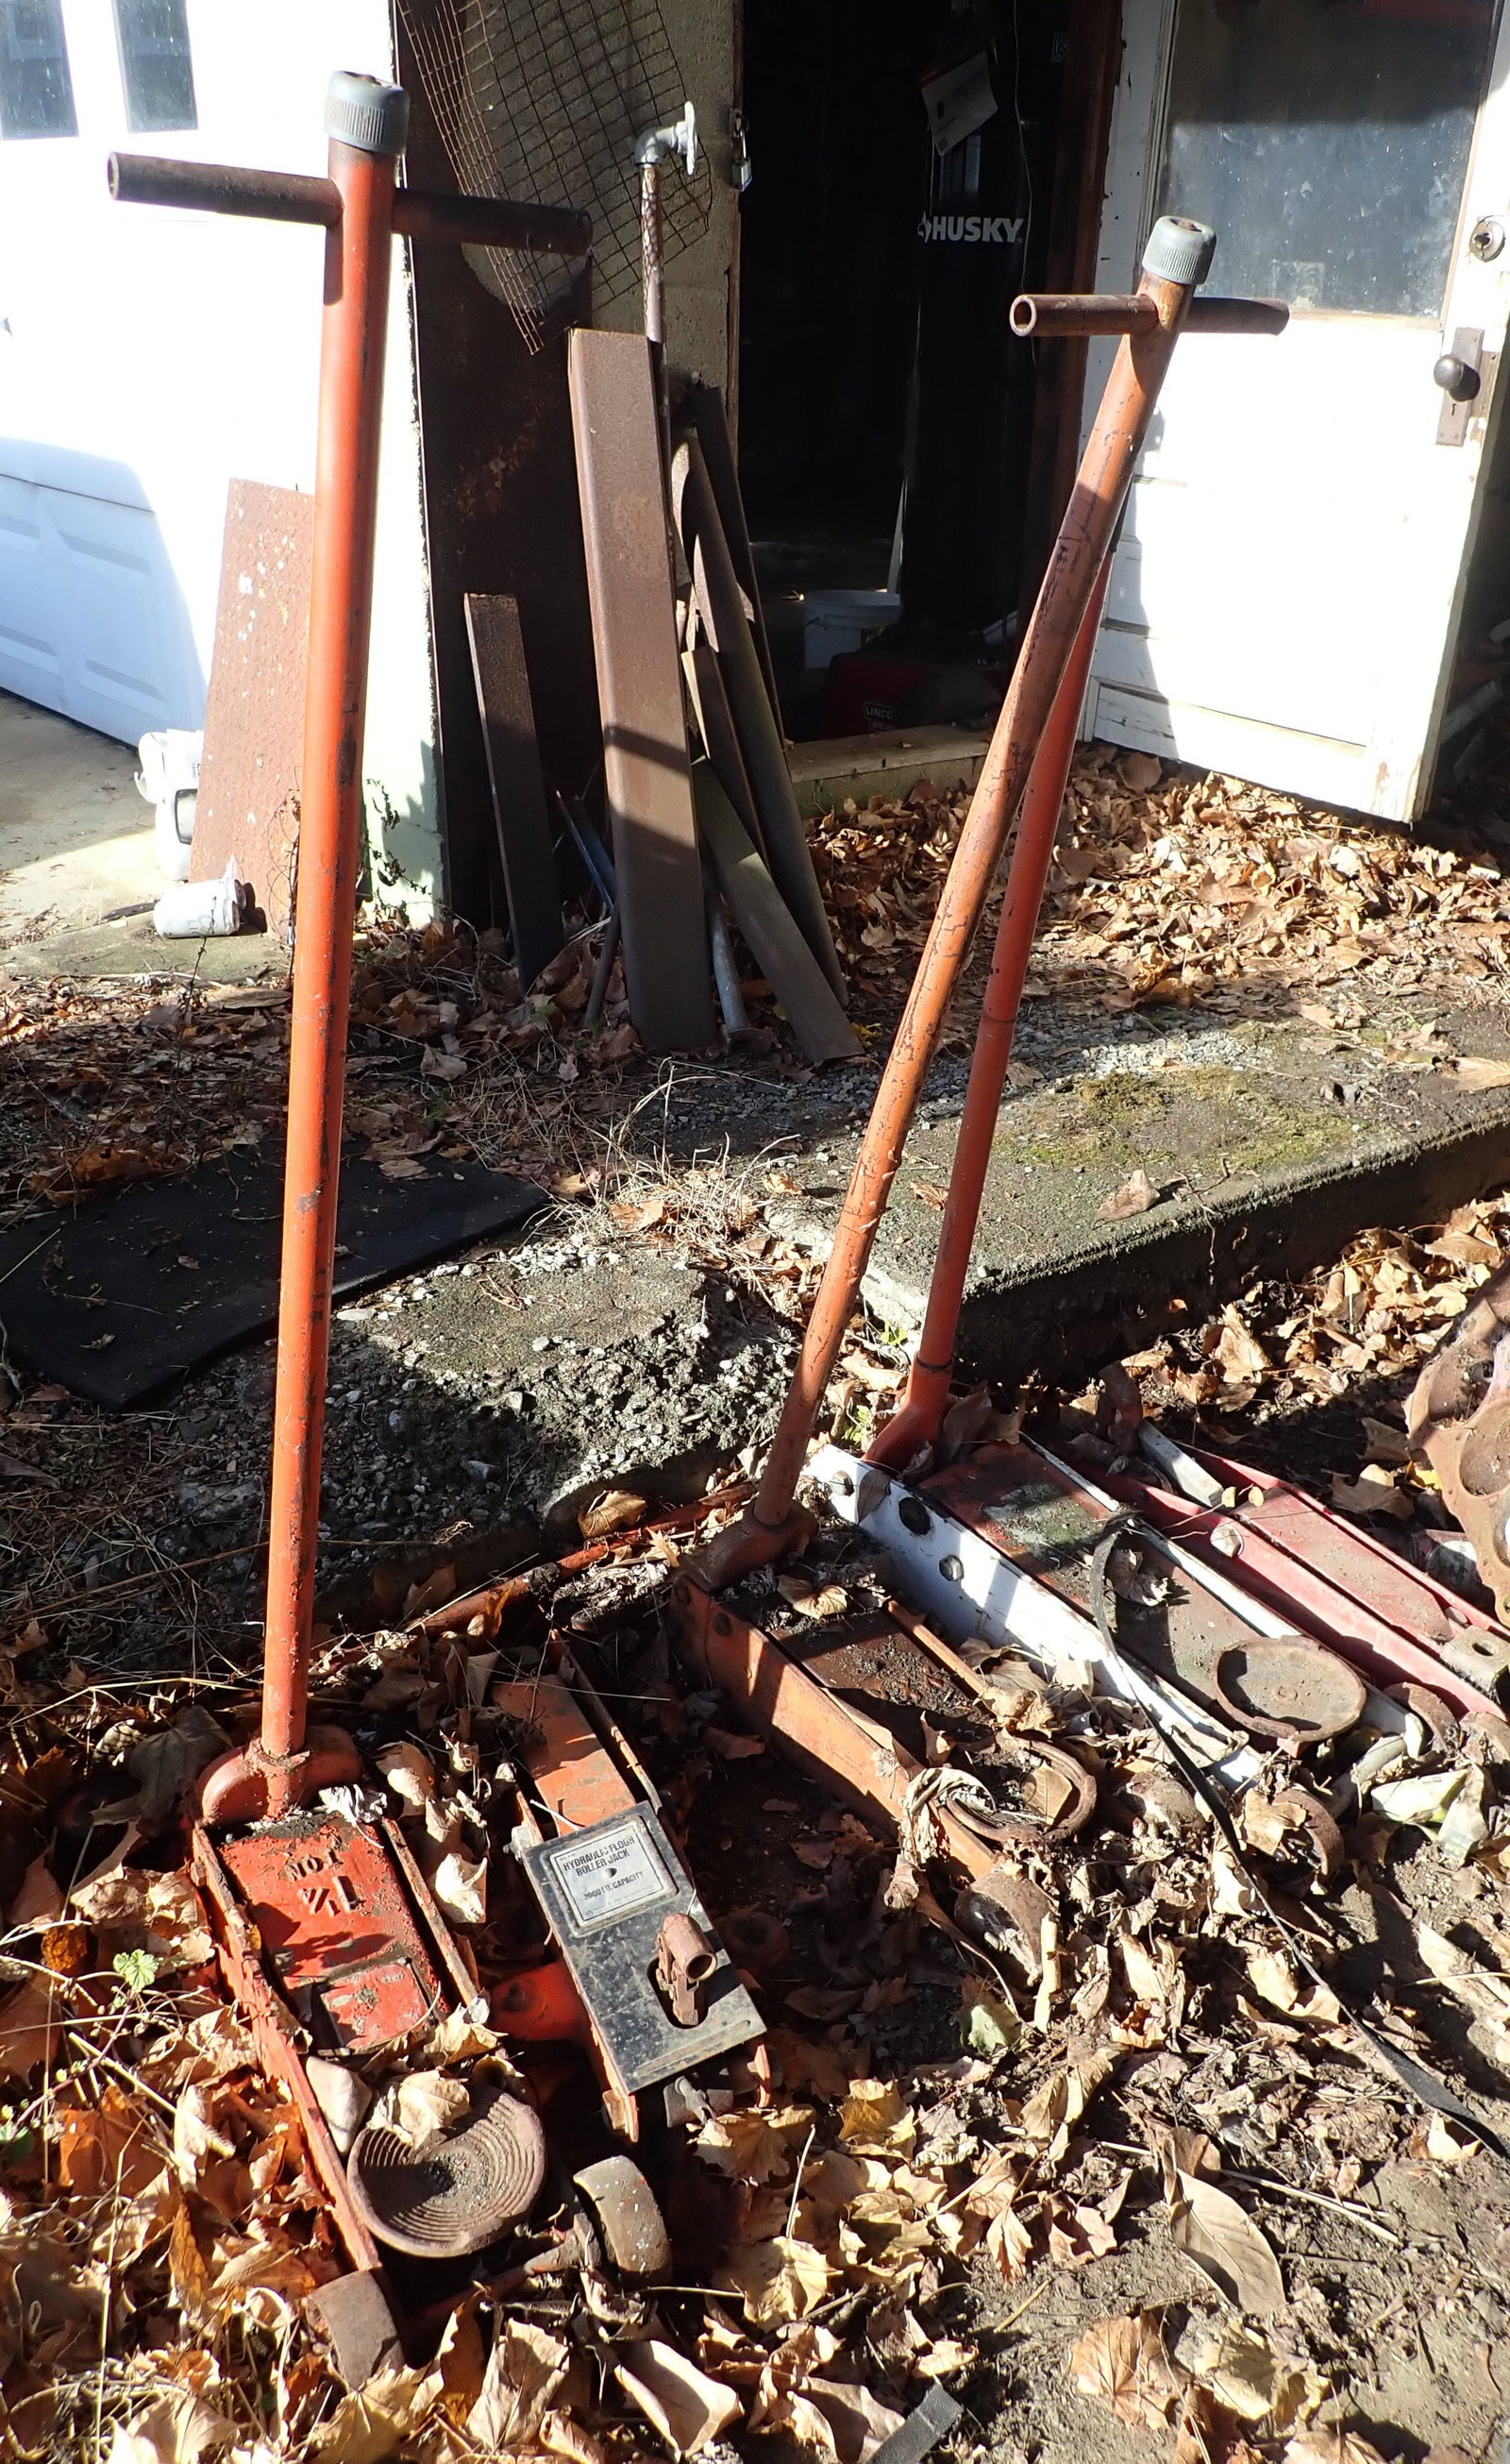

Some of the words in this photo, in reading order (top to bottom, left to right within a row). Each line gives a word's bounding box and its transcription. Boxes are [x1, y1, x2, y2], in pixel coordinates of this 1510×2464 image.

[932, 216, 1024, 243] HUSKY
[563, 1846, 609, 1871] HYDRAULIC
[577, 1858, 607, 1877] ROLLER
[608, 1848, 630, 1865] JACK
[583, 1888, 601, 1900] 3000
[612, 1870, 645, 1889] CAPACITY
